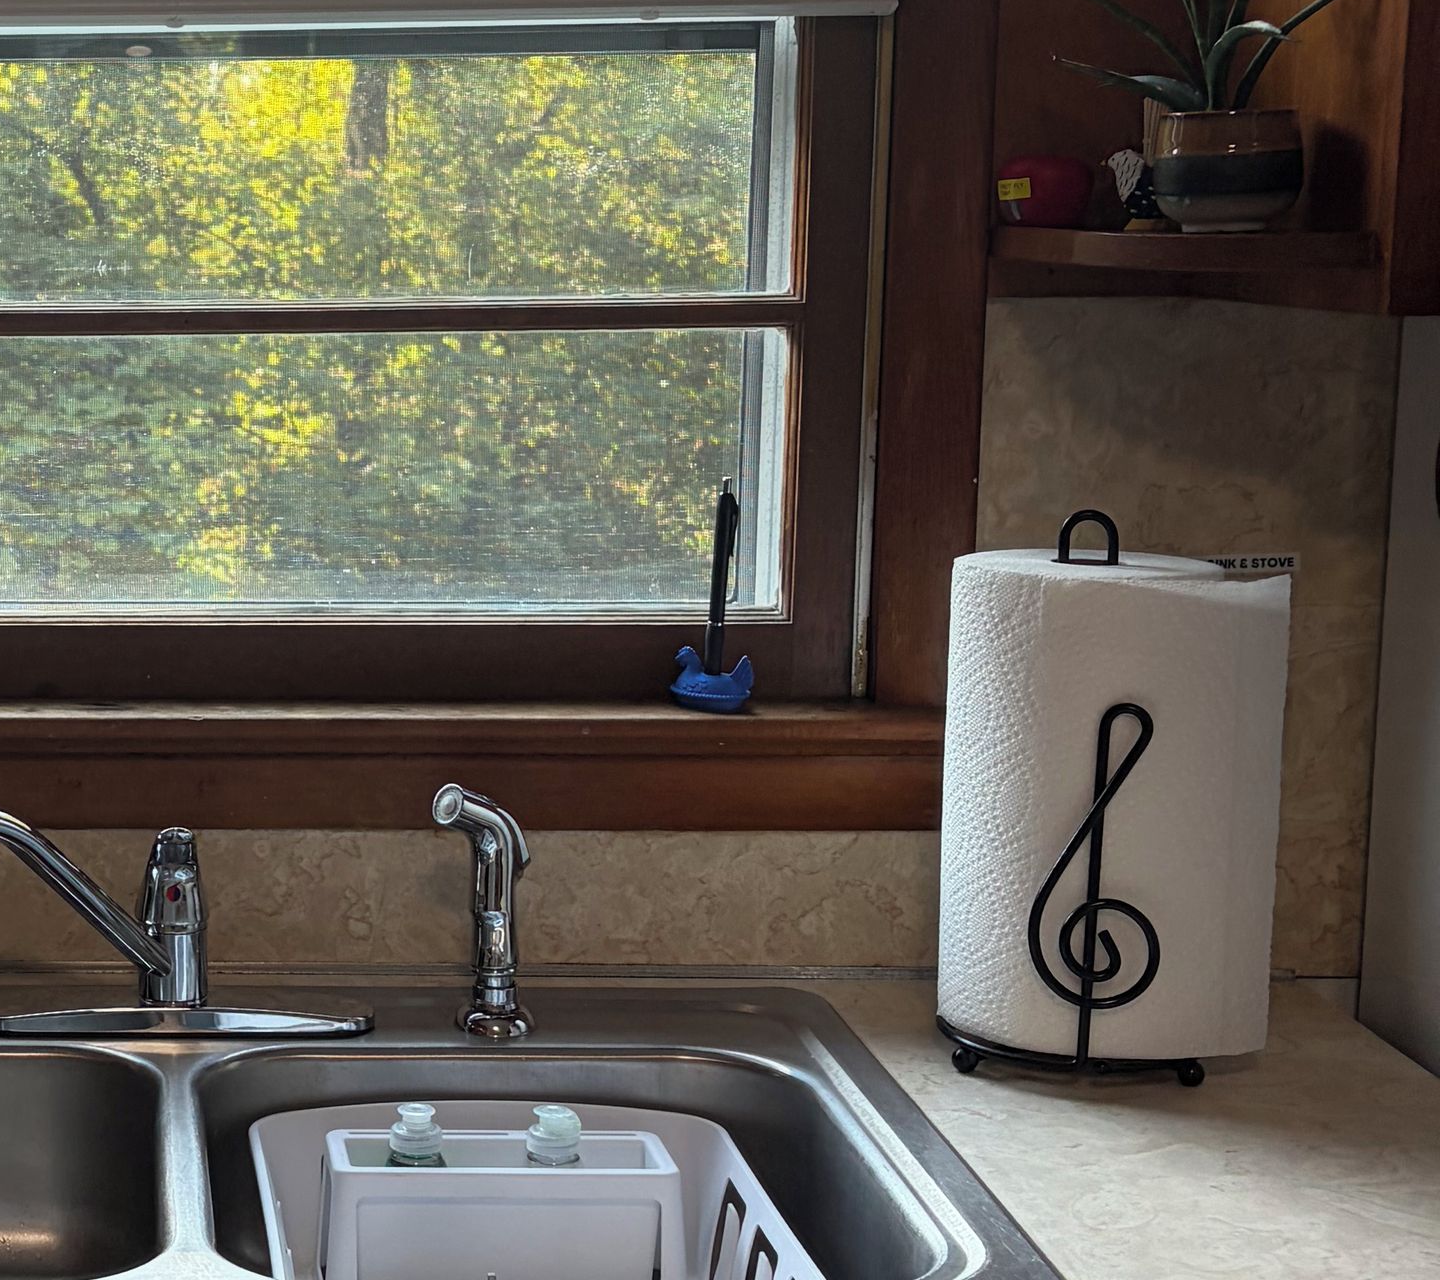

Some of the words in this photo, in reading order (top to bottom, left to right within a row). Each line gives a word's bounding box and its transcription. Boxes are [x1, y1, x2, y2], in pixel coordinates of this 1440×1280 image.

[1208, 559, 1236, 569] INK
[1240, 559, 1247, 568] &
[1252, 557, 1294, 568] STOVE
